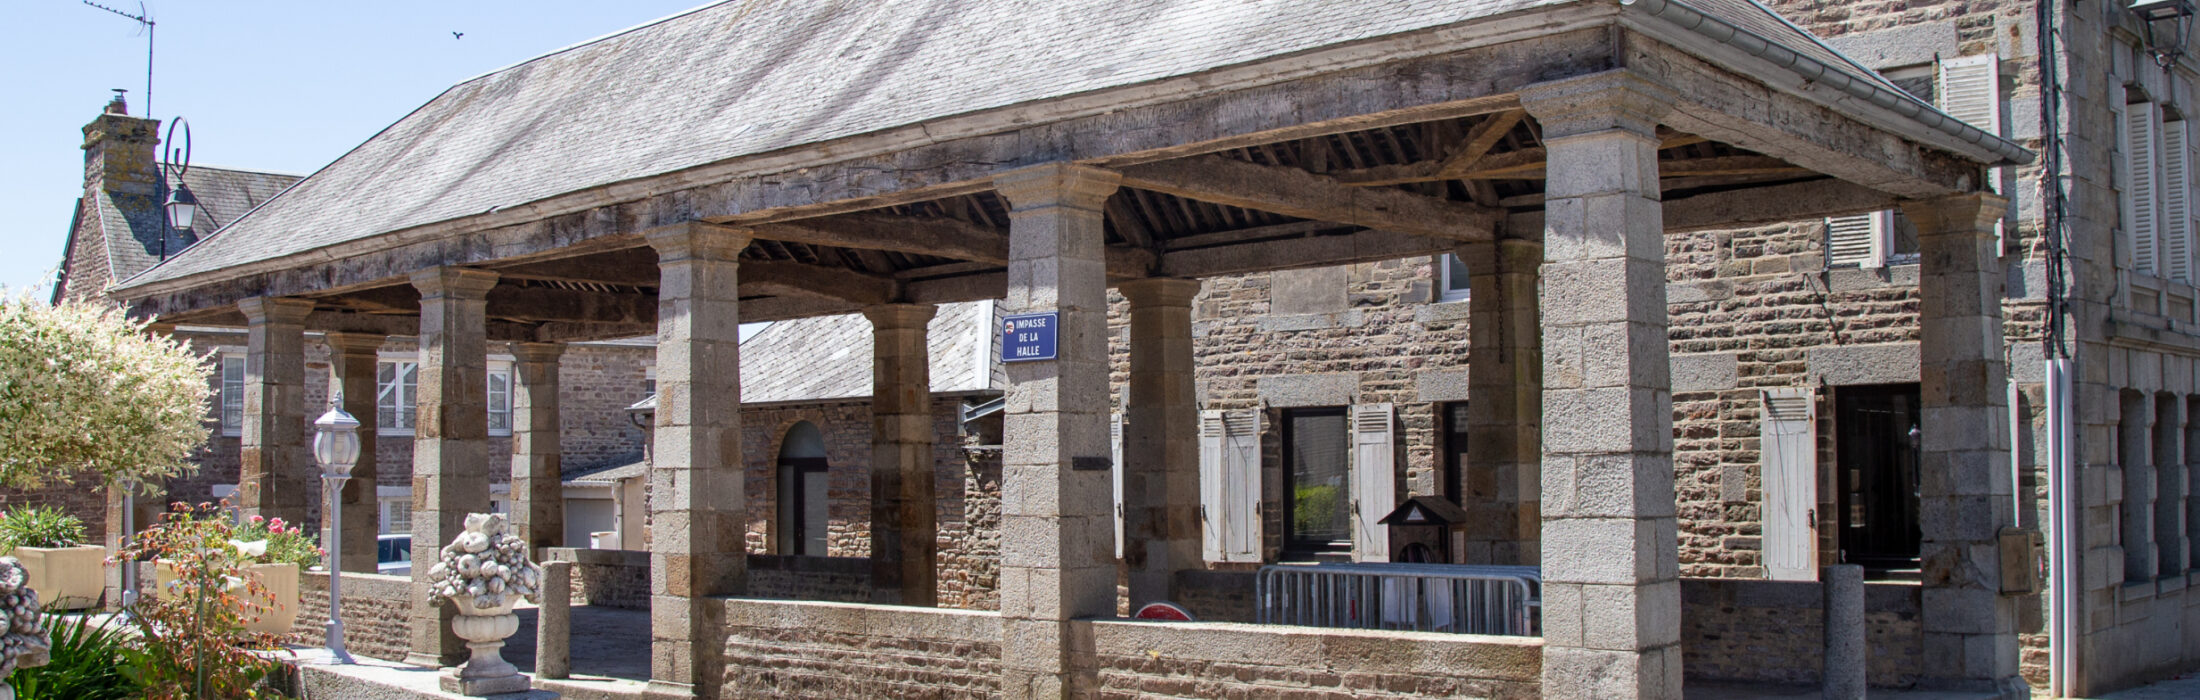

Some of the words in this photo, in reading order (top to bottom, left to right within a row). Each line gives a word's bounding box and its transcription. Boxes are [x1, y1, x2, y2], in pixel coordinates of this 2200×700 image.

[1016, 318, 1046, 329] IMPASSE
[1019, 333, 1028, 342] DE
[1030, 332, 1038, 342] LA
[1016, 345, 1040, 356] HALLE
